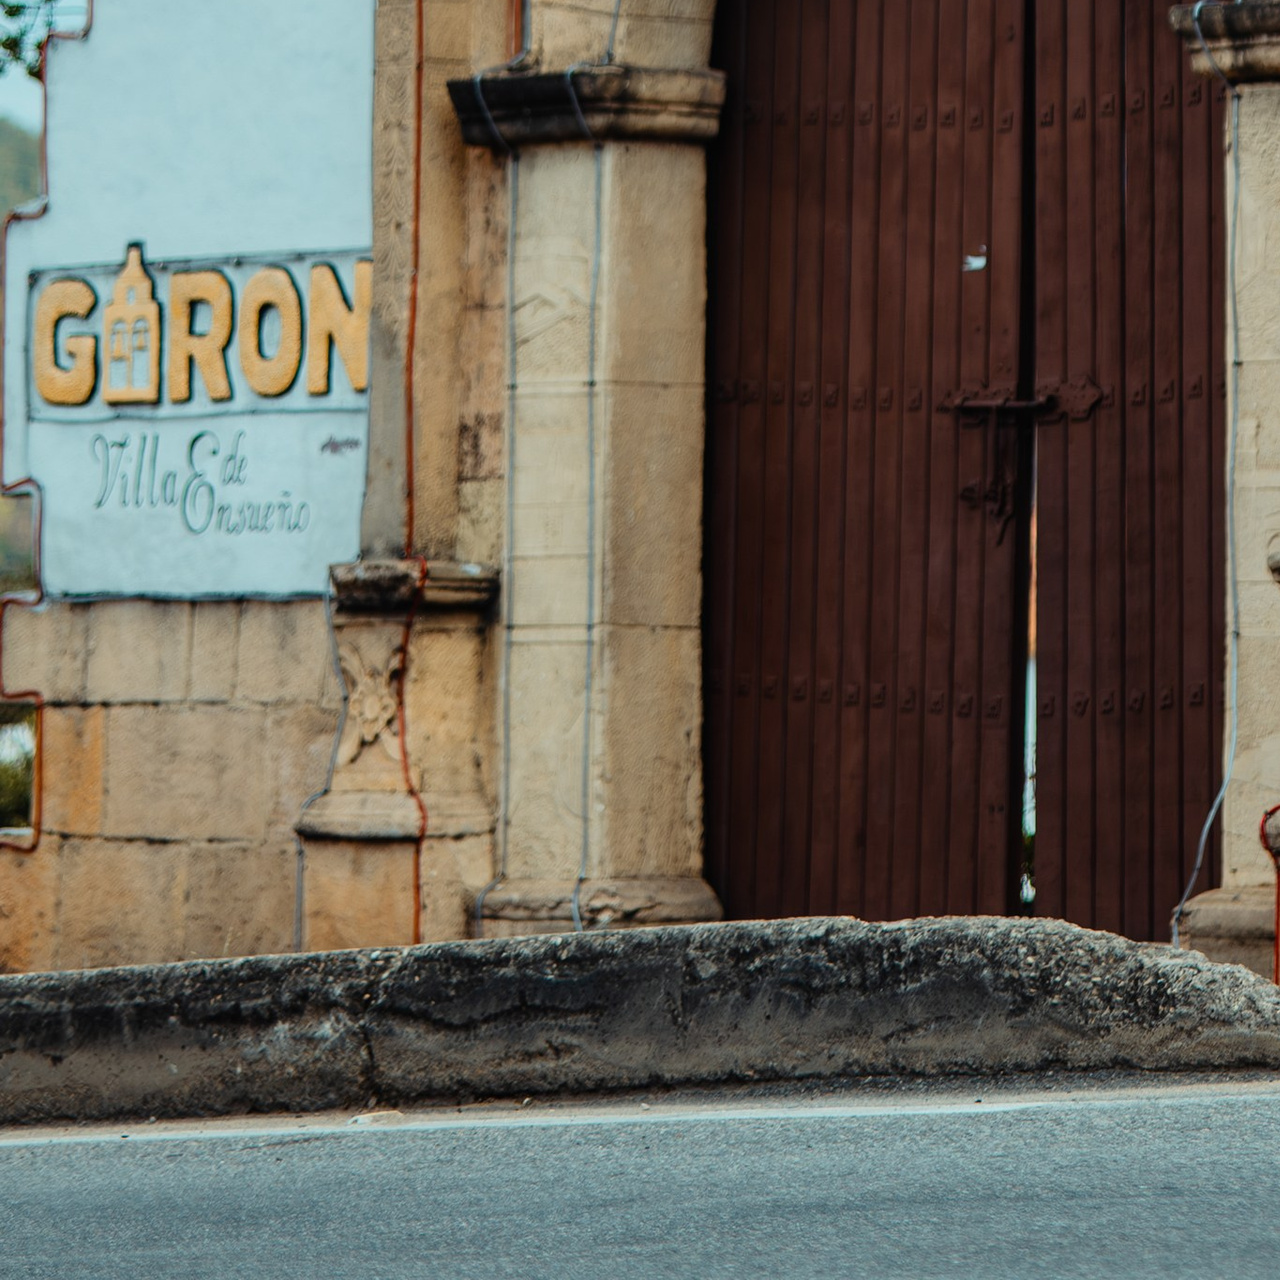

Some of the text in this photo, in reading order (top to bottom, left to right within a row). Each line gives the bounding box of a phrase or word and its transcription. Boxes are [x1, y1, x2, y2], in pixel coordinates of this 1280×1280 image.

[91, 429, 248, 509] Villa de
[181, 430, 310, 534] Ensueño
